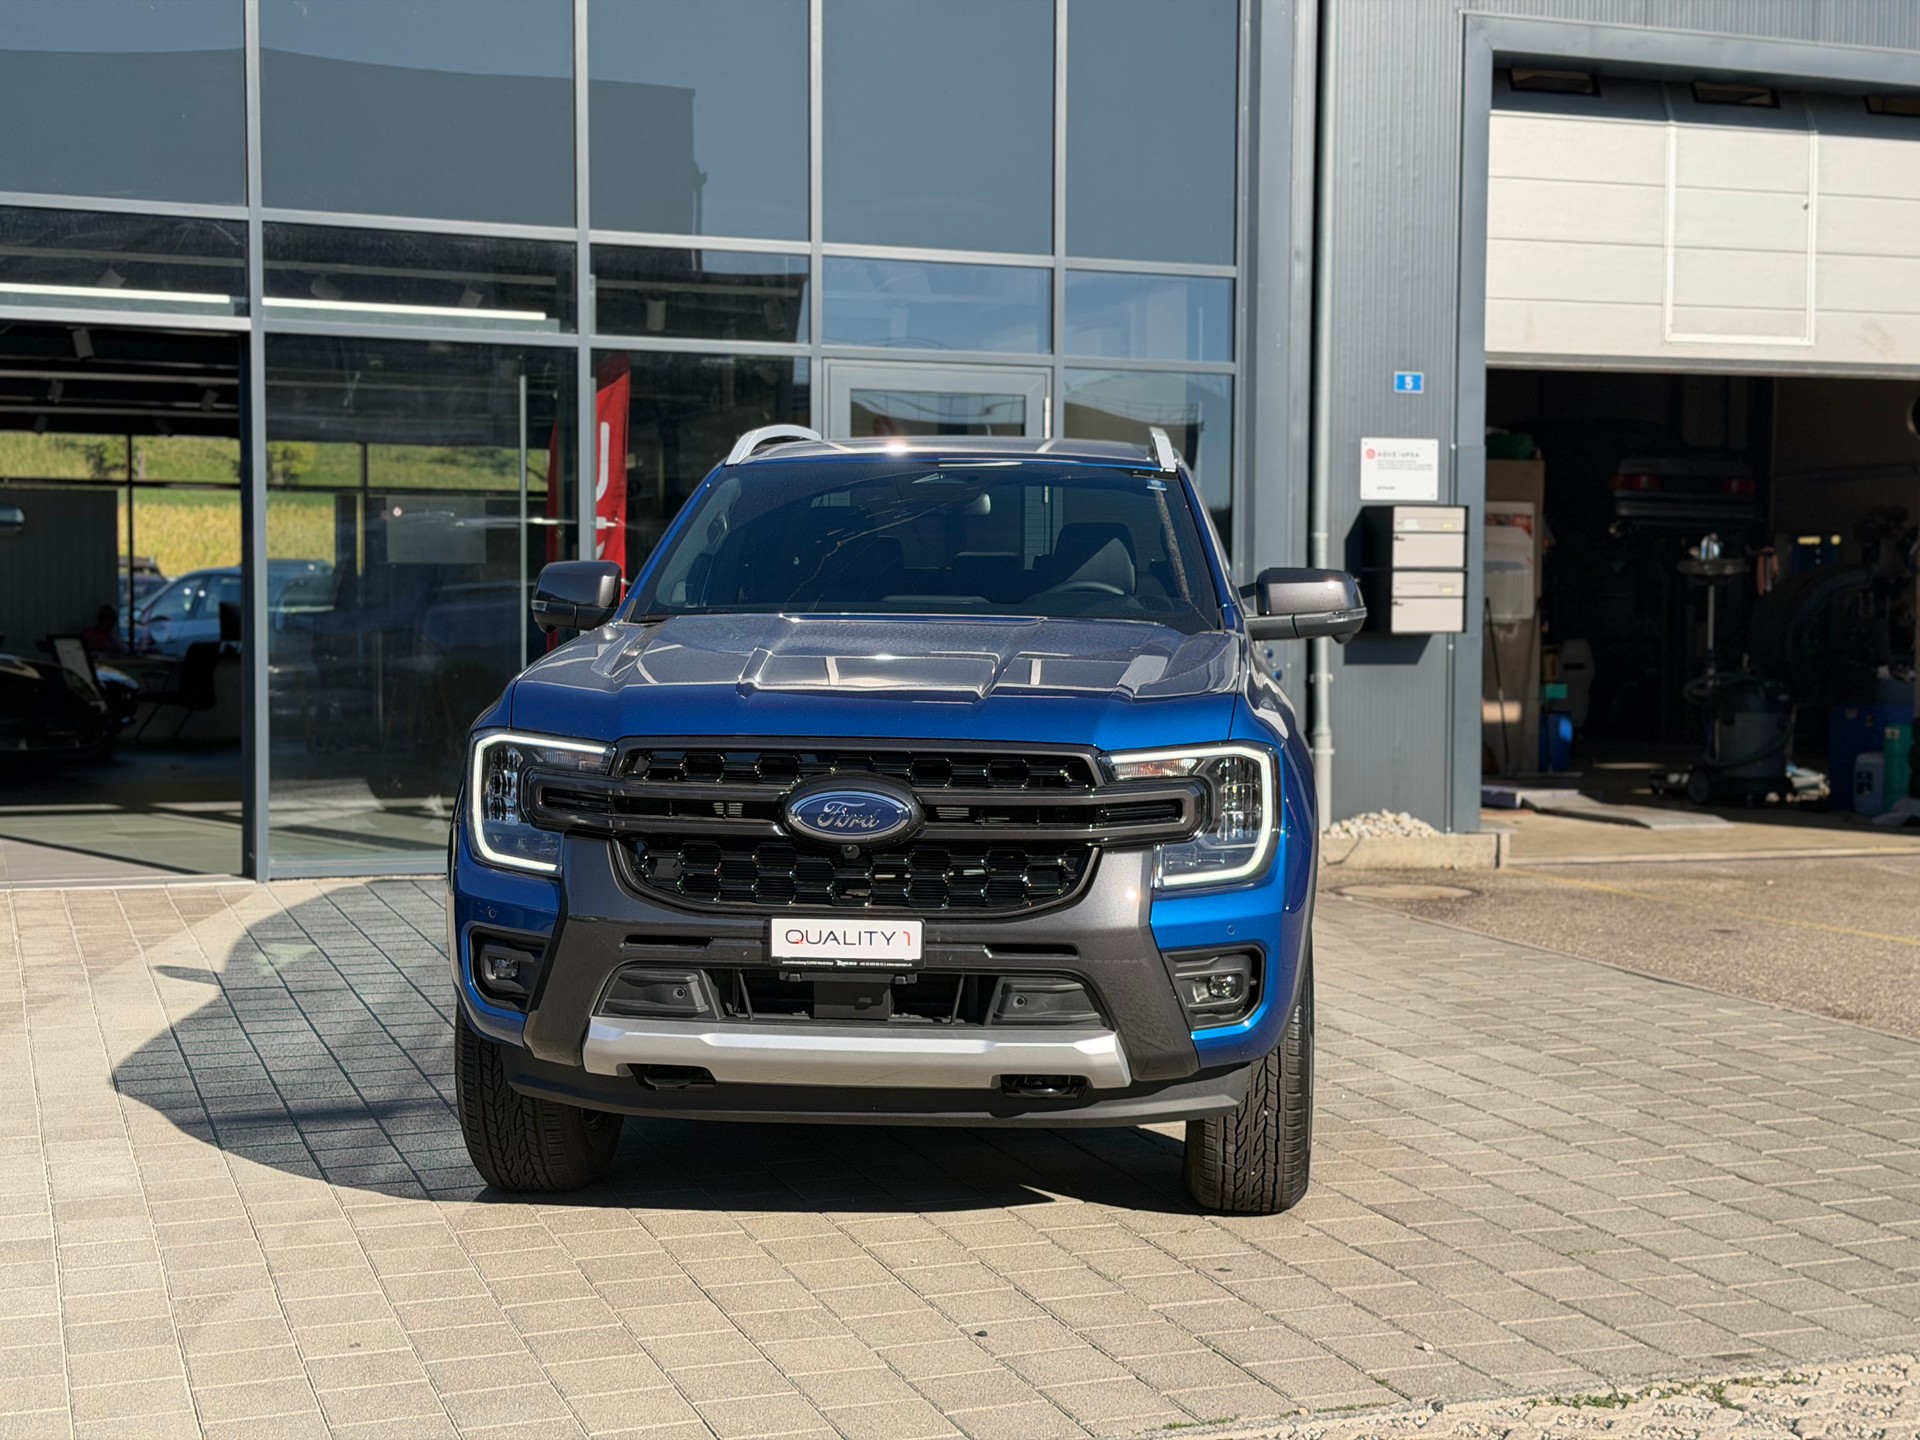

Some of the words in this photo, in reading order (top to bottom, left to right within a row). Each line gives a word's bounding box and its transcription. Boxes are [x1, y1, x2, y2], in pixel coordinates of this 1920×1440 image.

[1404, 375, 1414, 390] 5
[816, 801, 881, 829] Ford
[785, 929, 896, 946] QUALITY
